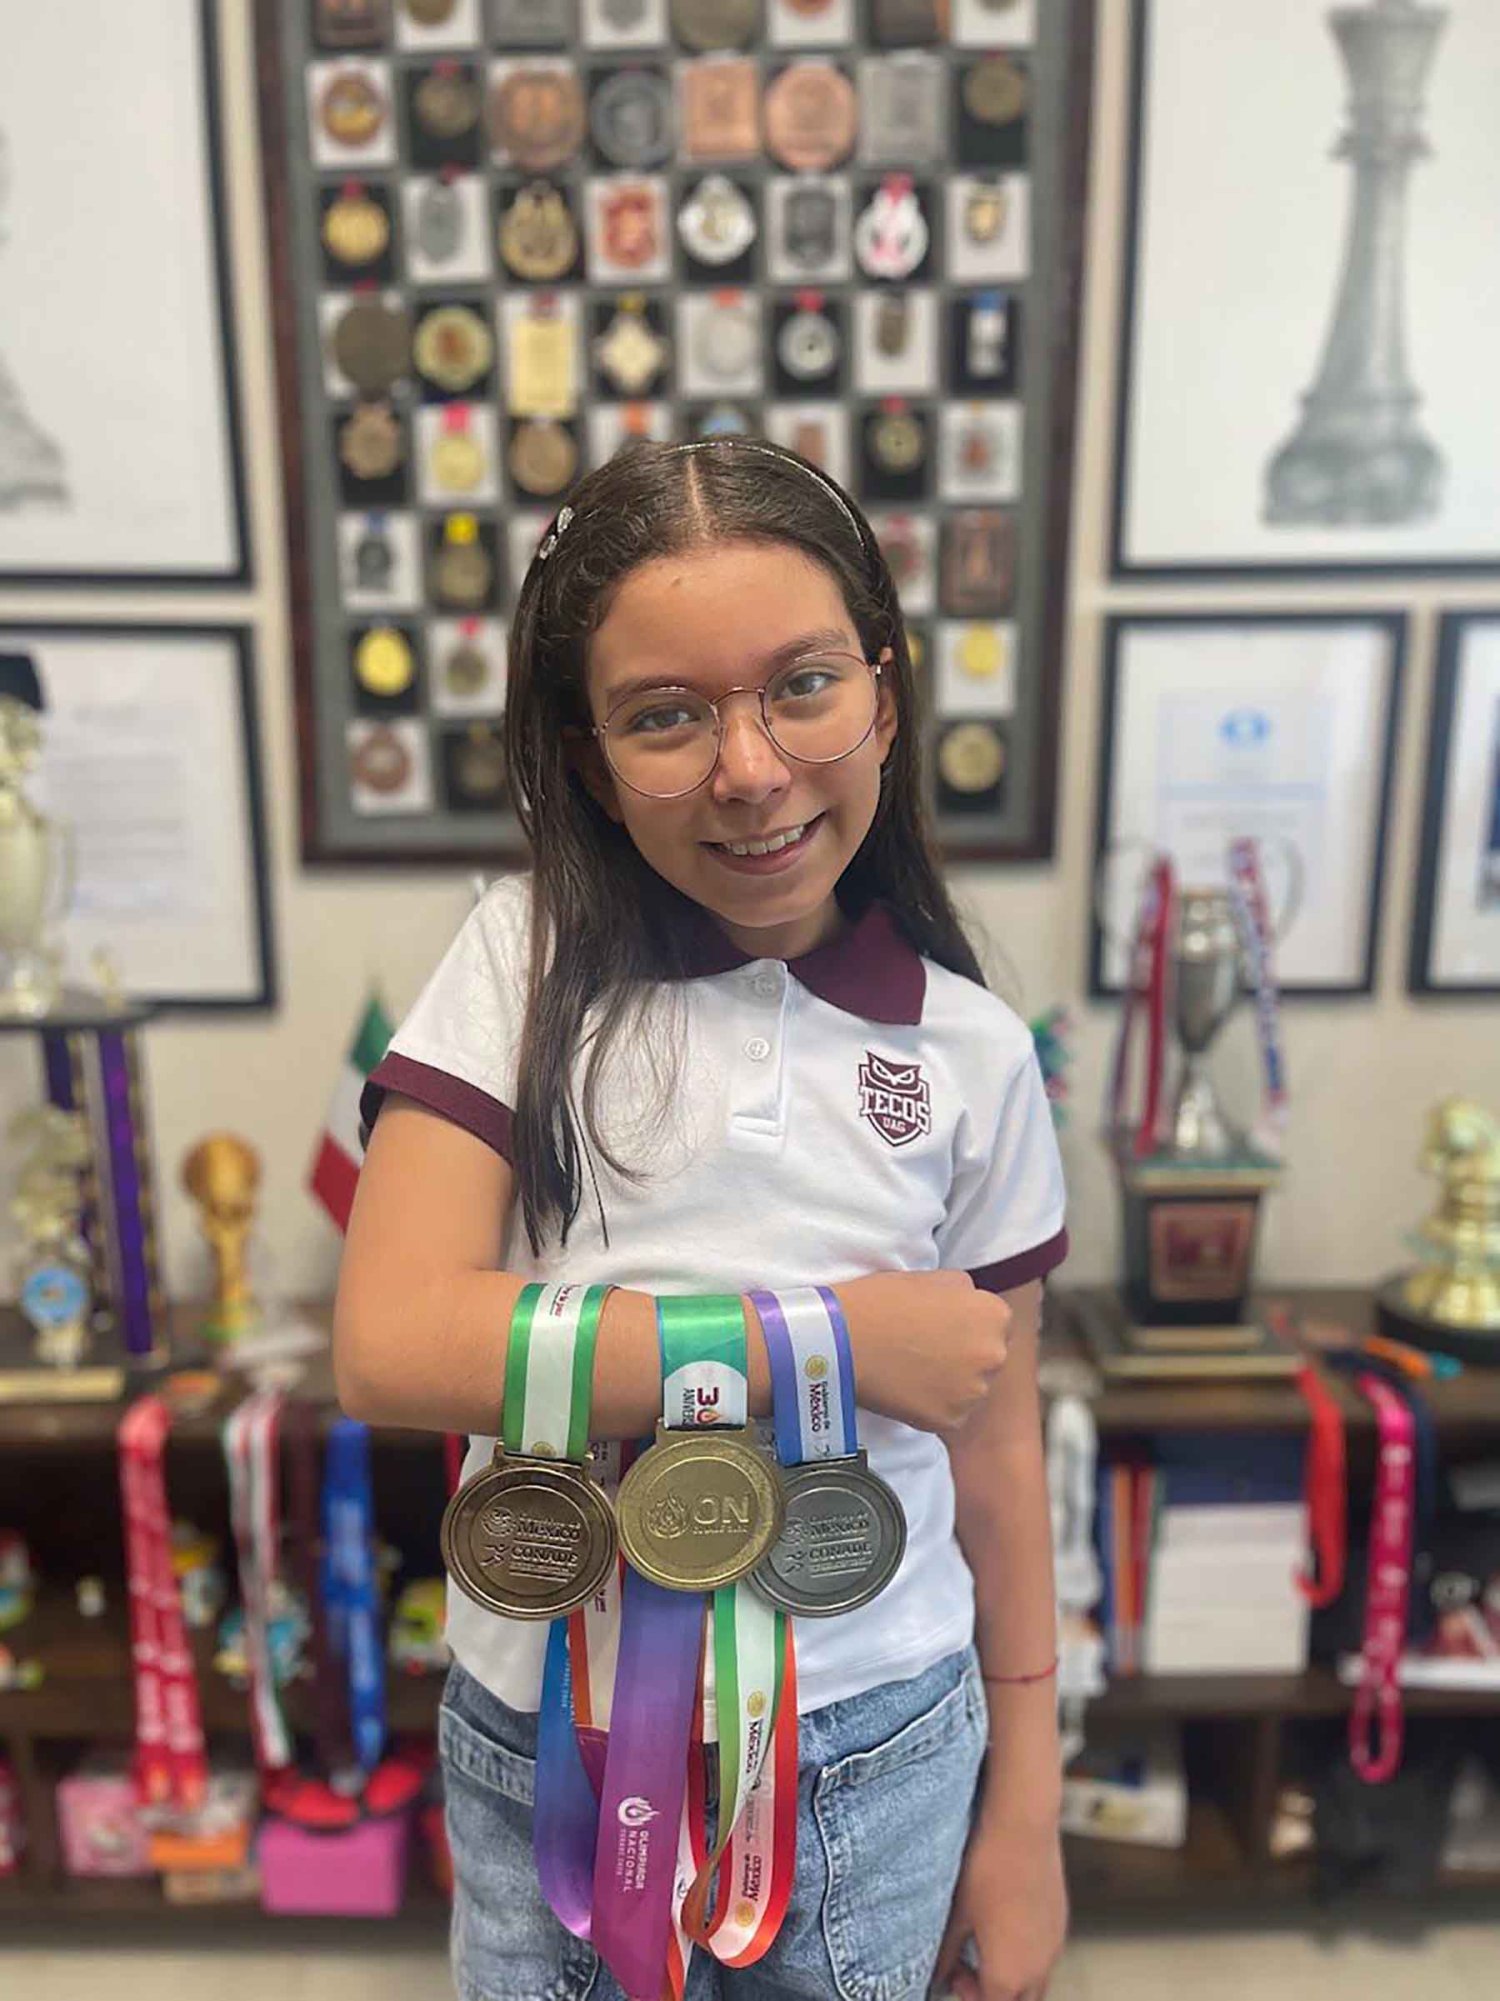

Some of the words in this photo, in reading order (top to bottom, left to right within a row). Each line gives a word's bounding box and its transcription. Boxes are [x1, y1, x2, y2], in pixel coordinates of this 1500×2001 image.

[860, 1086, 930, 1135] TECOS
[694, 1494, 750, 1524] ON
[511, 1547, 579, 1567] CONADE
[809, 1542, 872, 1562] CONADE
[622, 1830, 637, 1892] NACIONAL
